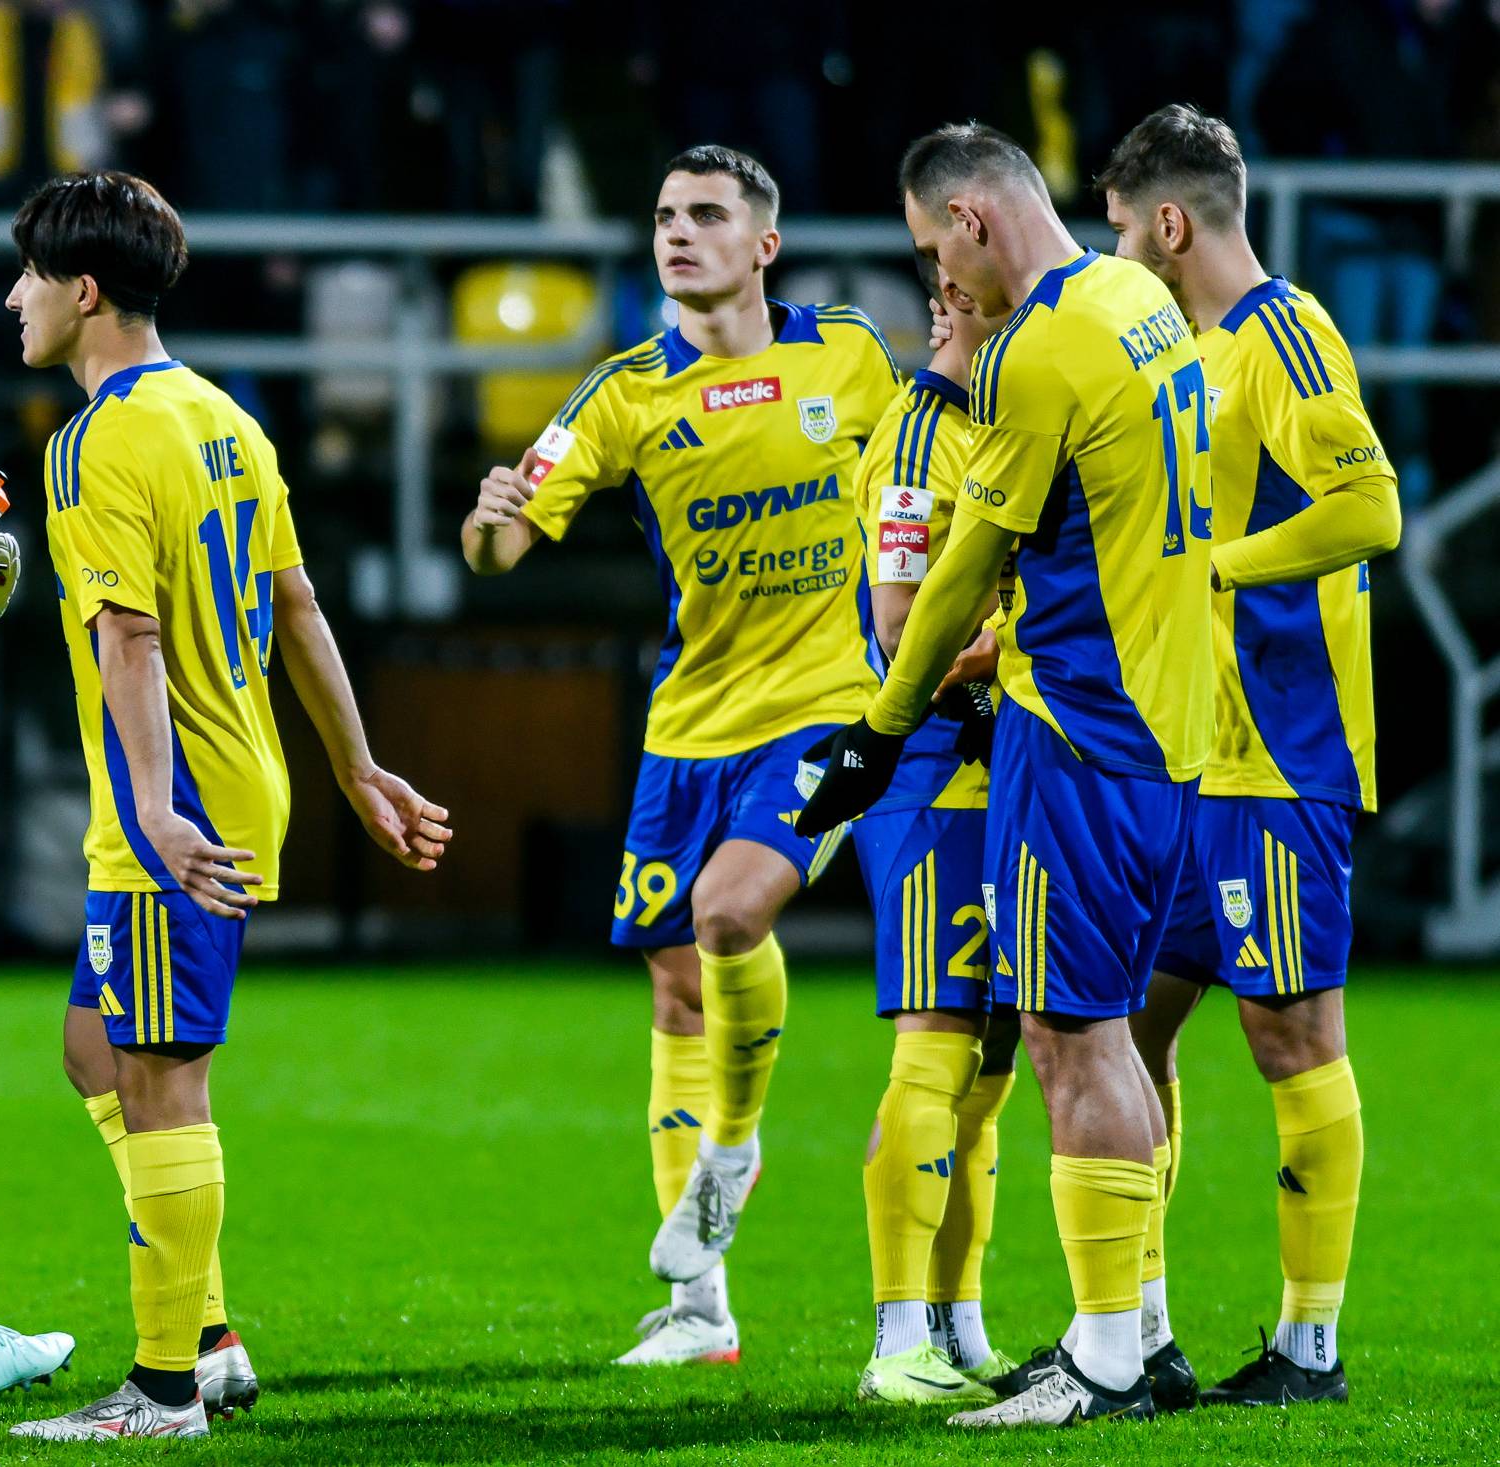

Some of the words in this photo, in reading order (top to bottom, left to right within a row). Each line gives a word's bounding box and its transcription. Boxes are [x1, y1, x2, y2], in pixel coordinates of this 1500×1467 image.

[707, 381, 775, 408] Betclic
[686, 473, 840, 533] GDYNIA
[883, 510, 923, 521] SUZUKI
[882, 530, 925, 544] Betclic
[738, 536, 844, 576] Energa
[739, 583, 792, 601] GRUPA
[796, 569, 846, 593] ORLEN
[613, 850, 677, 928] 39
